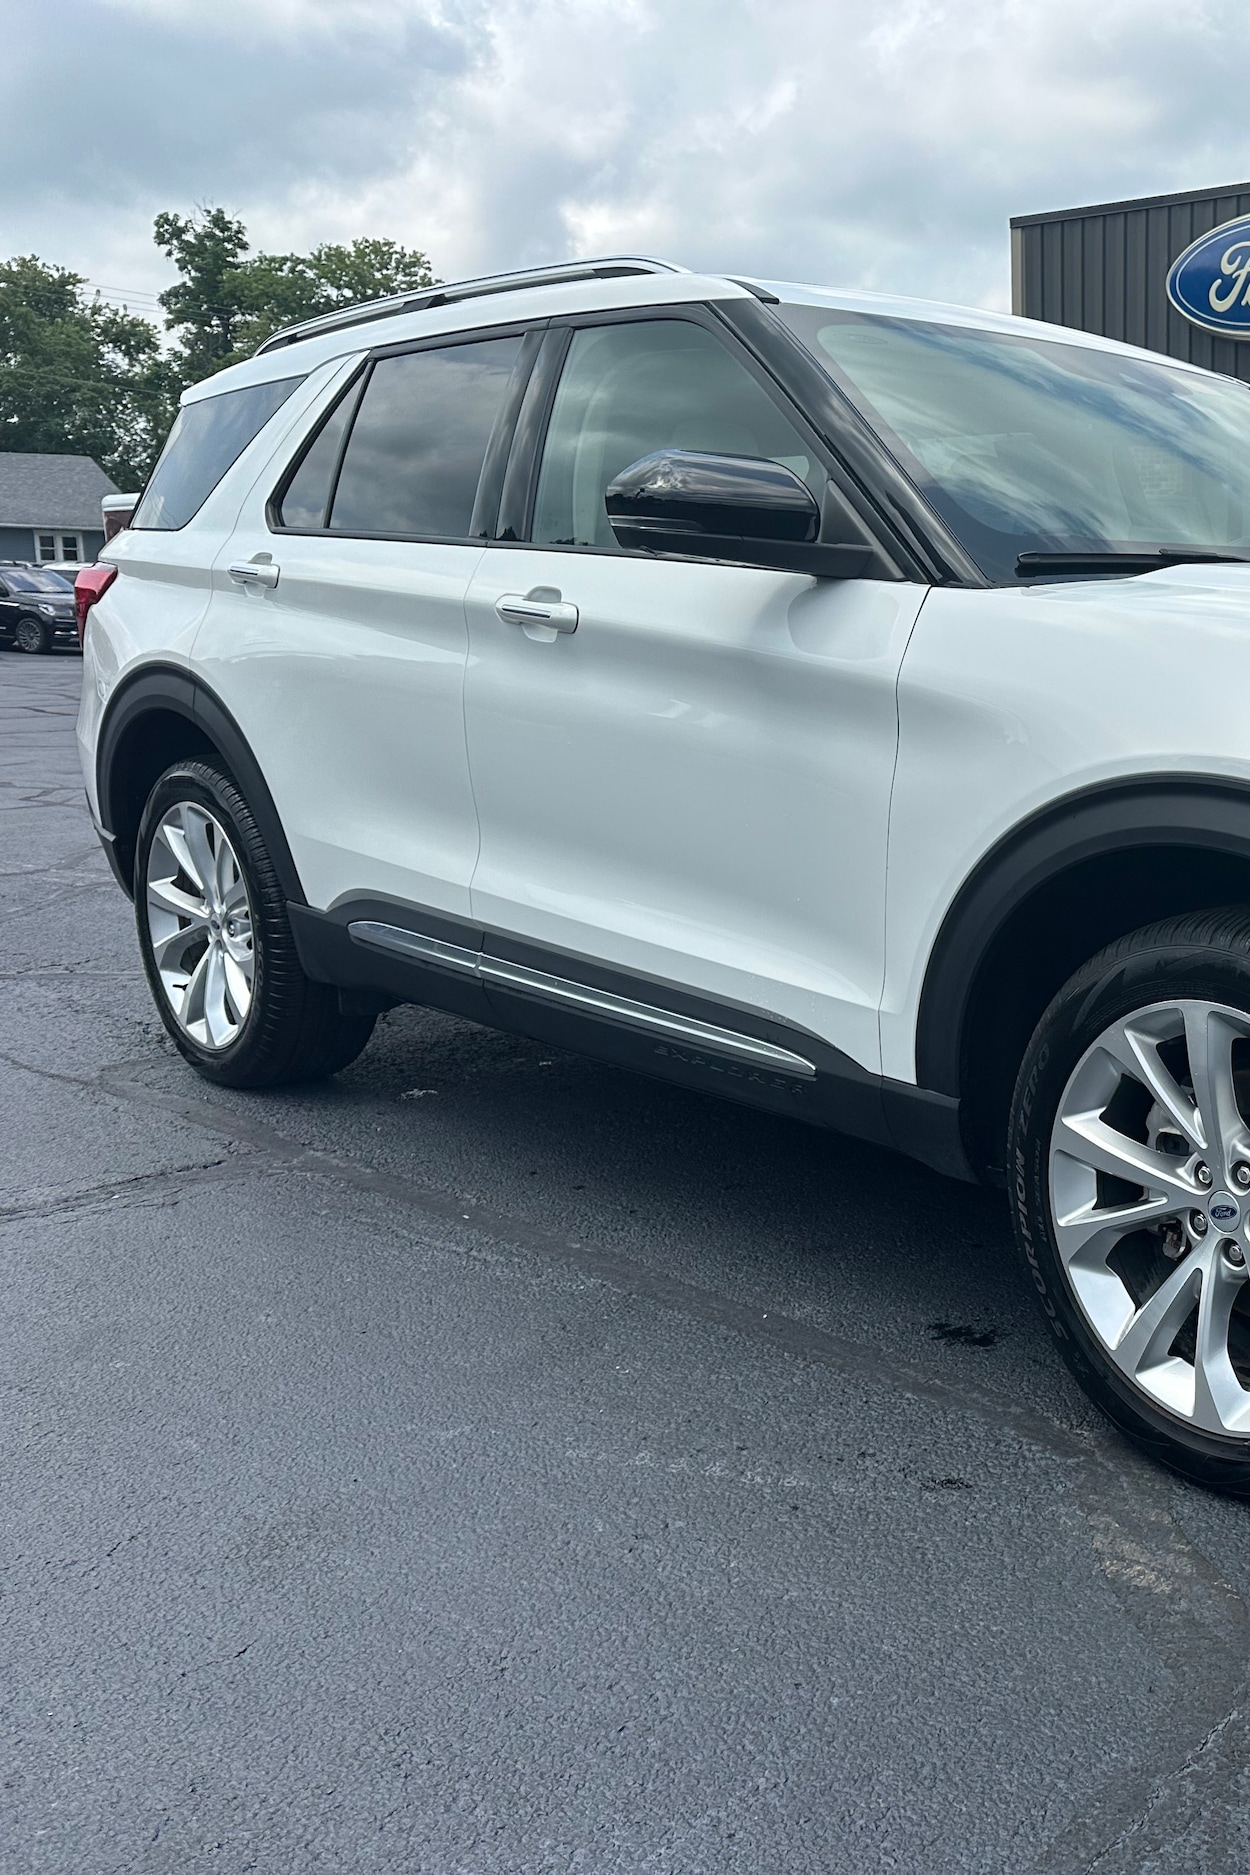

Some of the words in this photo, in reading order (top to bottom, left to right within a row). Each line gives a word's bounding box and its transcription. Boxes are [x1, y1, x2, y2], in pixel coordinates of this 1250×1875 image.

[654, 1045, 808, 1095] EXPLORER
[1017, 1042, 1052, 1137] ZERO
[1014, 1148, 1070, 1341] SCORPION
[1214, 1207, 1231, 1218] Ford
